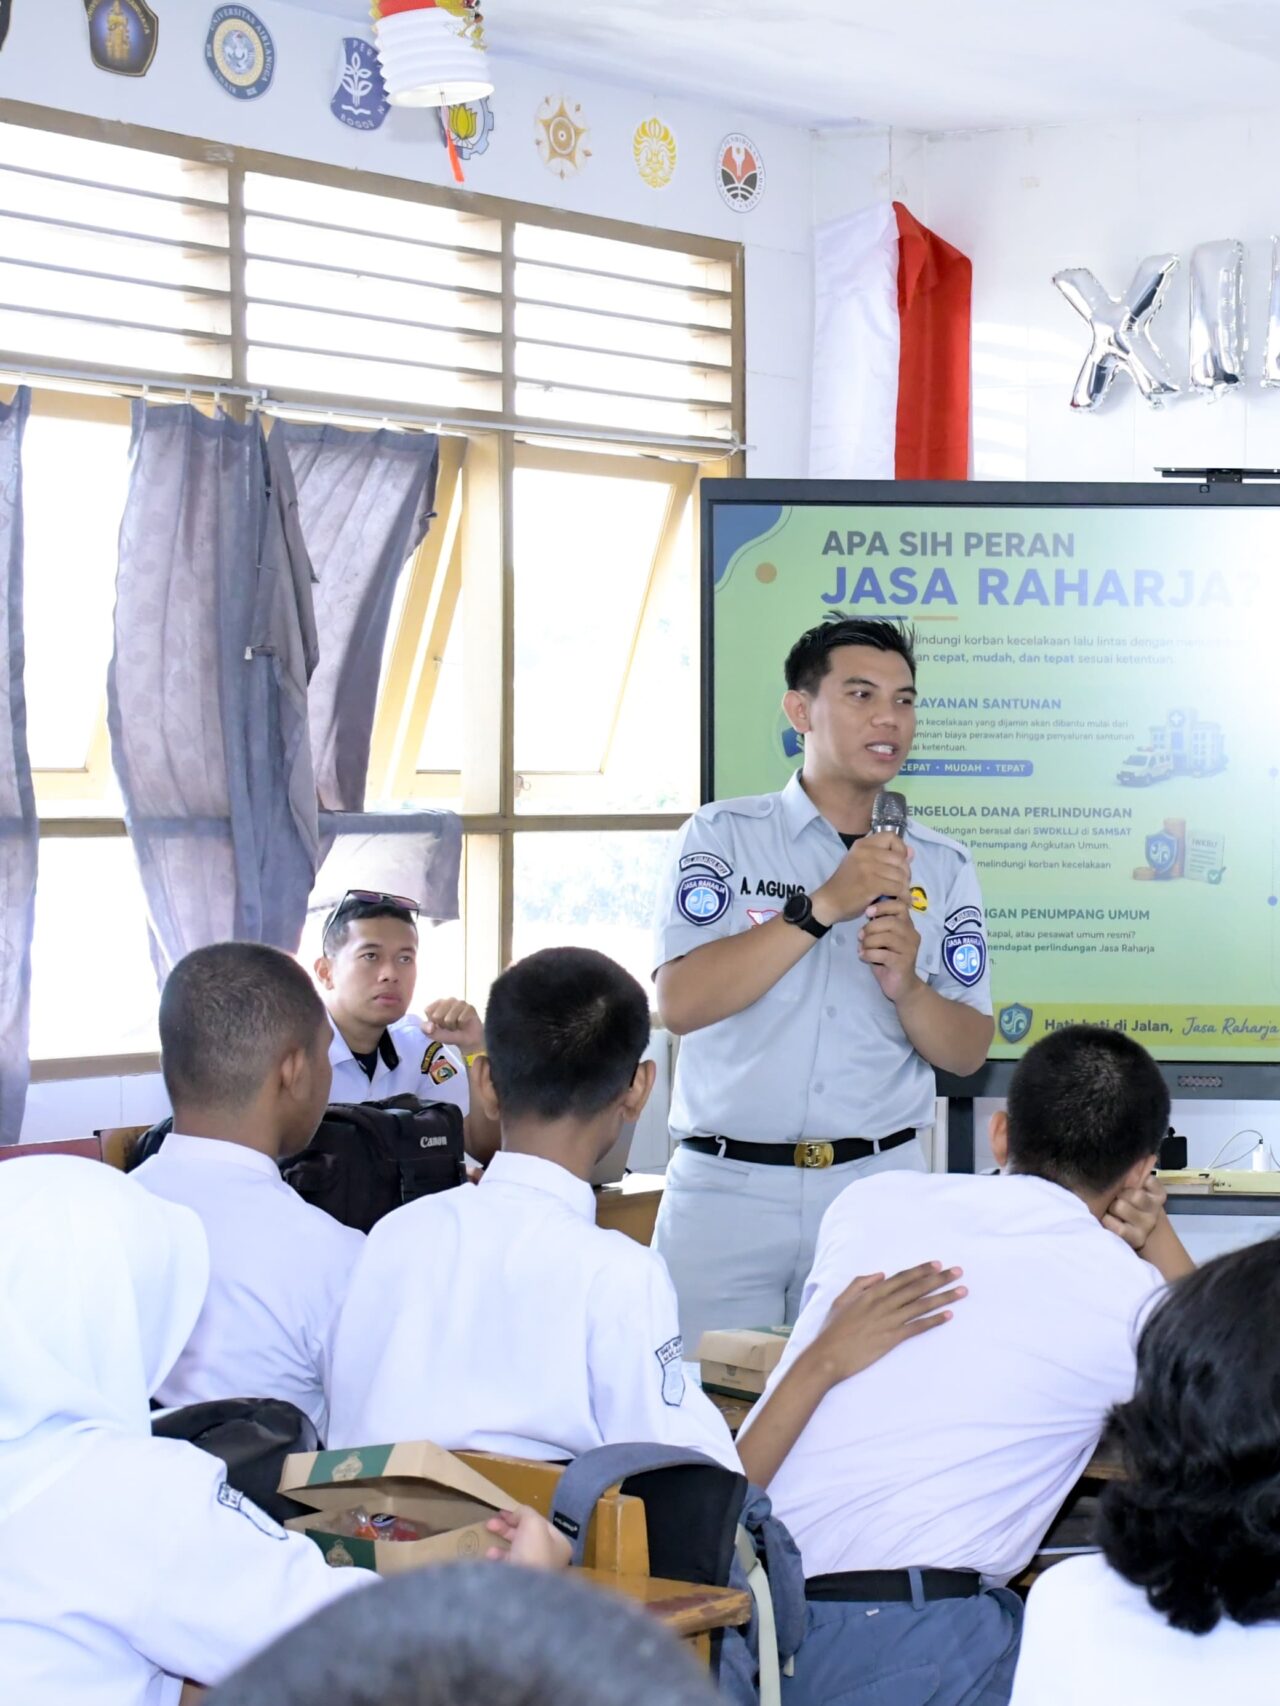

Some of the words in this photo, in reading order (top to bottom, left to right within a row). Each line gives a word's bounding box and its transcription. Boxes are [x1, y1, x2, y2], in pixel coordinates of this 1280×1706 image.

[822, 531, 889, 557] APA
[899, 532, 952, 558] SIH
[964, 533, 1075, 559] PERAN
[821, 567, 959, 607] JASA
[916, 634, 960, 648] lindungi
[964, 634, 1004, 646] korban
[1007, 635, 1071, 647] kecelakaan
[1074, 636, 1094, 647] lalu
[1097, 636, 1127, 648] lintas
[933, 653, 969, 665] cepat,
[972, 653, 1015, 665] mudah,
[1019, 653, 1040, 664] dan
[1044, 654, 1074, 666] tepat
[1078, 655, 1113, 665] sesuai
[983, 698, 1061, 710] SANTUNAN
[925, 718, 973, 727] kecelakaan
[976, 720, 996, 730] yang
[998, 719, 1028, 730] dijamin
[1031, 720, 1051, 728] akan
[1053, 719, 1084, 728] dibantu
[1087, 719, 1111, 728] mulai
[914, 731, 942, 739] aminan
[945, 731, 967, 741] biaya
[970, 732, 1013, 741] perawatan
[1016, 732, 1045, 742] hingga
[1047, 732, 1094, 743] penyaluran
[1096, 733, 1134, 741] santunan
[945, 764, 982, 772] MUDAH
[996, 764, 1025, 773] TEPAT
[906, 806, 977, 818] ENGELOLA
[981, 807, 1020, 818] DANA
[1024, 807, 1132, 819] PERLINDUNGAN
[979, 827, 1011, 836] berasal
[1014, 827, 1030, 836] dari
[1080, 828, 1089, 836] di
[1092, 828, 1131, 836] SAMSAT
[970, 840, 1028, 851] Penumpang
[1031, 841, 1075, 851] Angkutan
[977, 860, 1026, 870] melindungi
[1029, 860, 1059, 869] korban
[1062, 861, 1111, 869] kecelakaan
[1021, 909, 1105, 920] PENUMPANG
[1108, 909, 1150, 920] UMUM
[1016, 931, 1035, 939] atau
[1037, 931, 1074, 941] pesawat
[1107, 931, 1136, 940] resmi?
[1034, 944, 1097, 954] perlindungan
[1100, 944, 1119, 953] Jasa
[1122, 945, 1155, 955] Raharja
[1131, 1019, 1173, 1034] Jalan,
[1182, 1016, 1217, 1035] Jasa
[1222, 1018, 1280, 1039] Raharja
